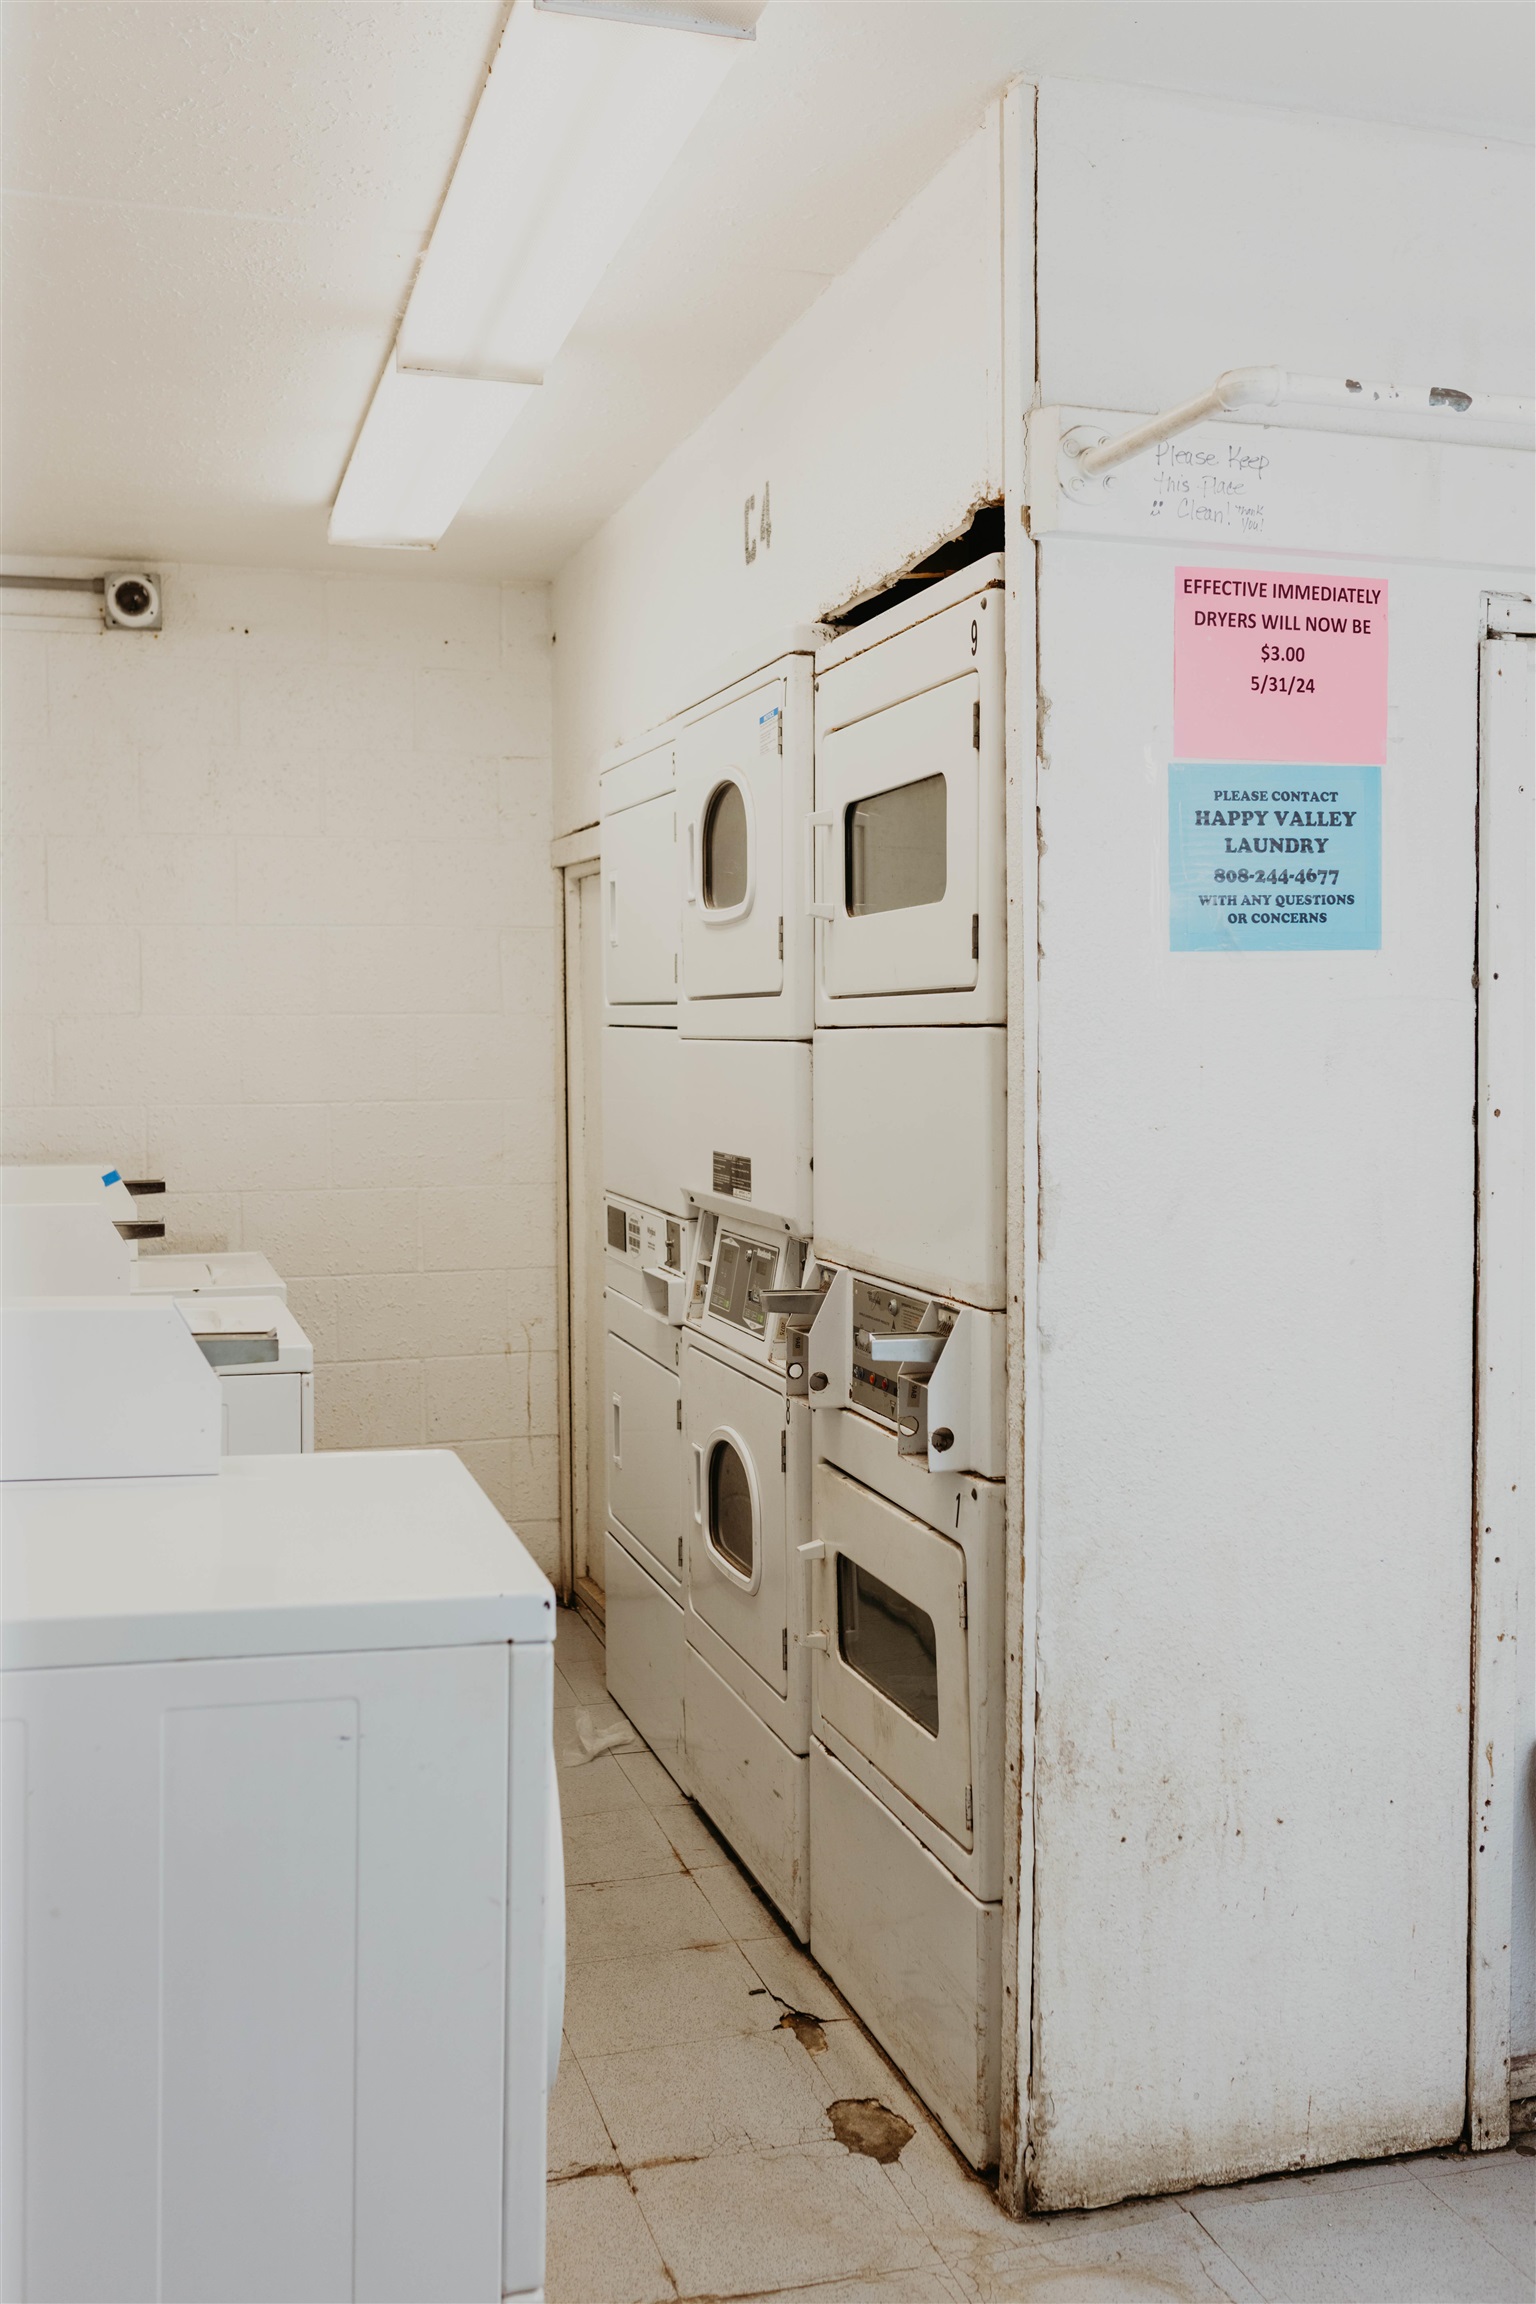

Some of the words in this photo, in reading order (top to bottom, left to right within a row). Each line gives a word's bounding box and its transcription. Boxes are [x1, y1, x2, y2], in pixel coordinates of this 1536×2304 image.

[1155, 440, 1219, 467] Please
[1228, 445, 1270, 480] Keep
[1177, 497, 1231, 526] Clean!
[1184, 579, 1267, 598] EFFECTIVE
[1273, 583, 1381, 604] IMMEDIATELY
[1194, 610, 1257, 629] DRYERS
[1262, 614, 1300, 631] WILL
[1306, 616, 1347, 633] NOW
[1352, 619, 1371, 634] BE
[971, 619, 978, 657] 9
[1261, 643, 1305, 663] $3.00
[1250, 674, 1315, 695] 5/31/24
[1214, 790, 1269, 802] PLEASE
[1271, 791, 1339, 803] CONTACT
[1195, 810, 1269, 826] HAPPY
[1274, 810, 1357, 827] VALLEY
[1225, 837, 1329, 853] LAUNDRY
[1214, 867, 1340, 885] 808-244-4677
[1199, 894, 1238, 906] WITH
[1241, 894, 1272, 906] ANY
[1275, 894, 1355, 908] QUESTIONS
[1227, 913, 1248, 924] OR
[1251, 912, 1328, 924] CONCERNS
[955, 1492, 961, 1528] 1
